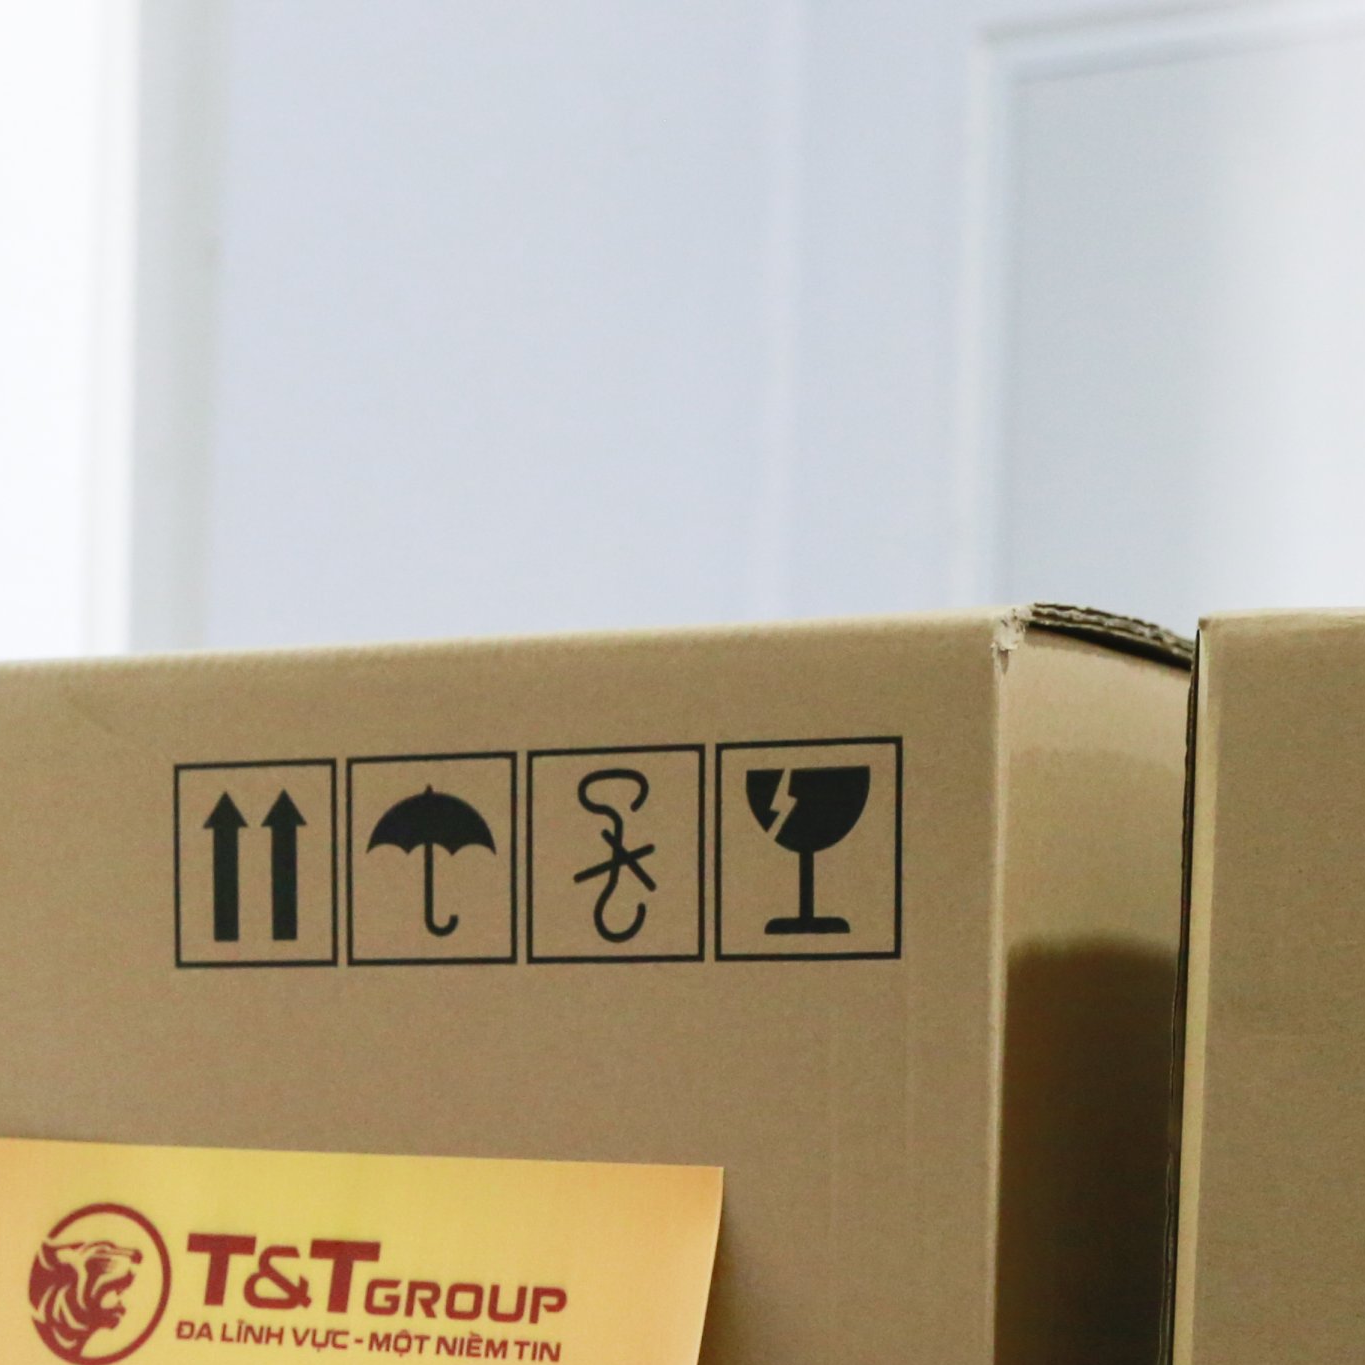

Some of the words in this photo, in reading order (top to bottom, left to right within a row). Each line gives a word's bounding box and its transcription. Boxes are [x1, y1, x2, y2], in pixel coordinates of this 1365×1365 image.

[174, 1319, 214, 1342] ĐA
[291, 1325, 351, 1353] VỰC
[367, 1328, 432, 1358] MỘT
[434, 1331, 510, 1360] NIỀM
[513, 1339, 562, 1364] TIN
